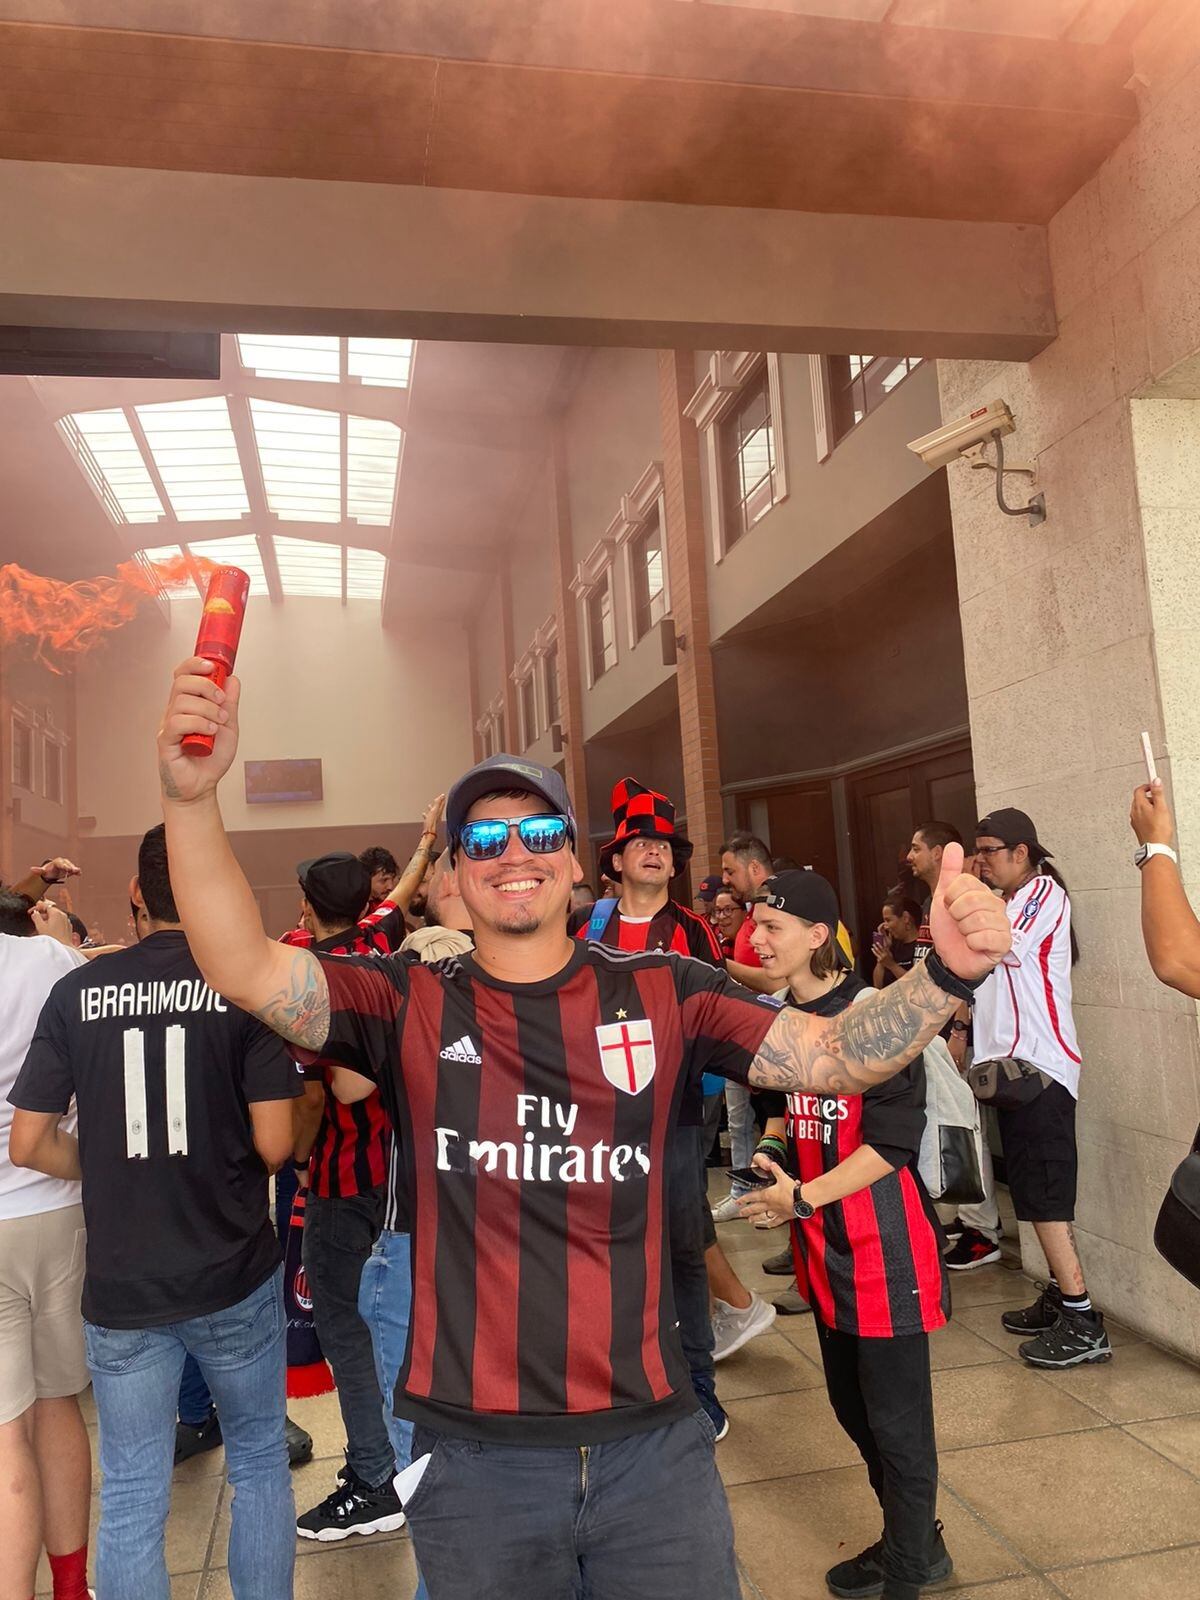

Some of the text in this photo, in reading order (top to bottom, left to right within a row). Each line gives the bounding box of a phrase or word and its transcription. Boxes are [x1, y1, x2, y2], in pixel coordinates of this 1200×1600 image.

[440, 1049, 482, 1065] adidas
[123, 1024, 188, 1160] 11
[516, 1093, 579, 1136] Fly
